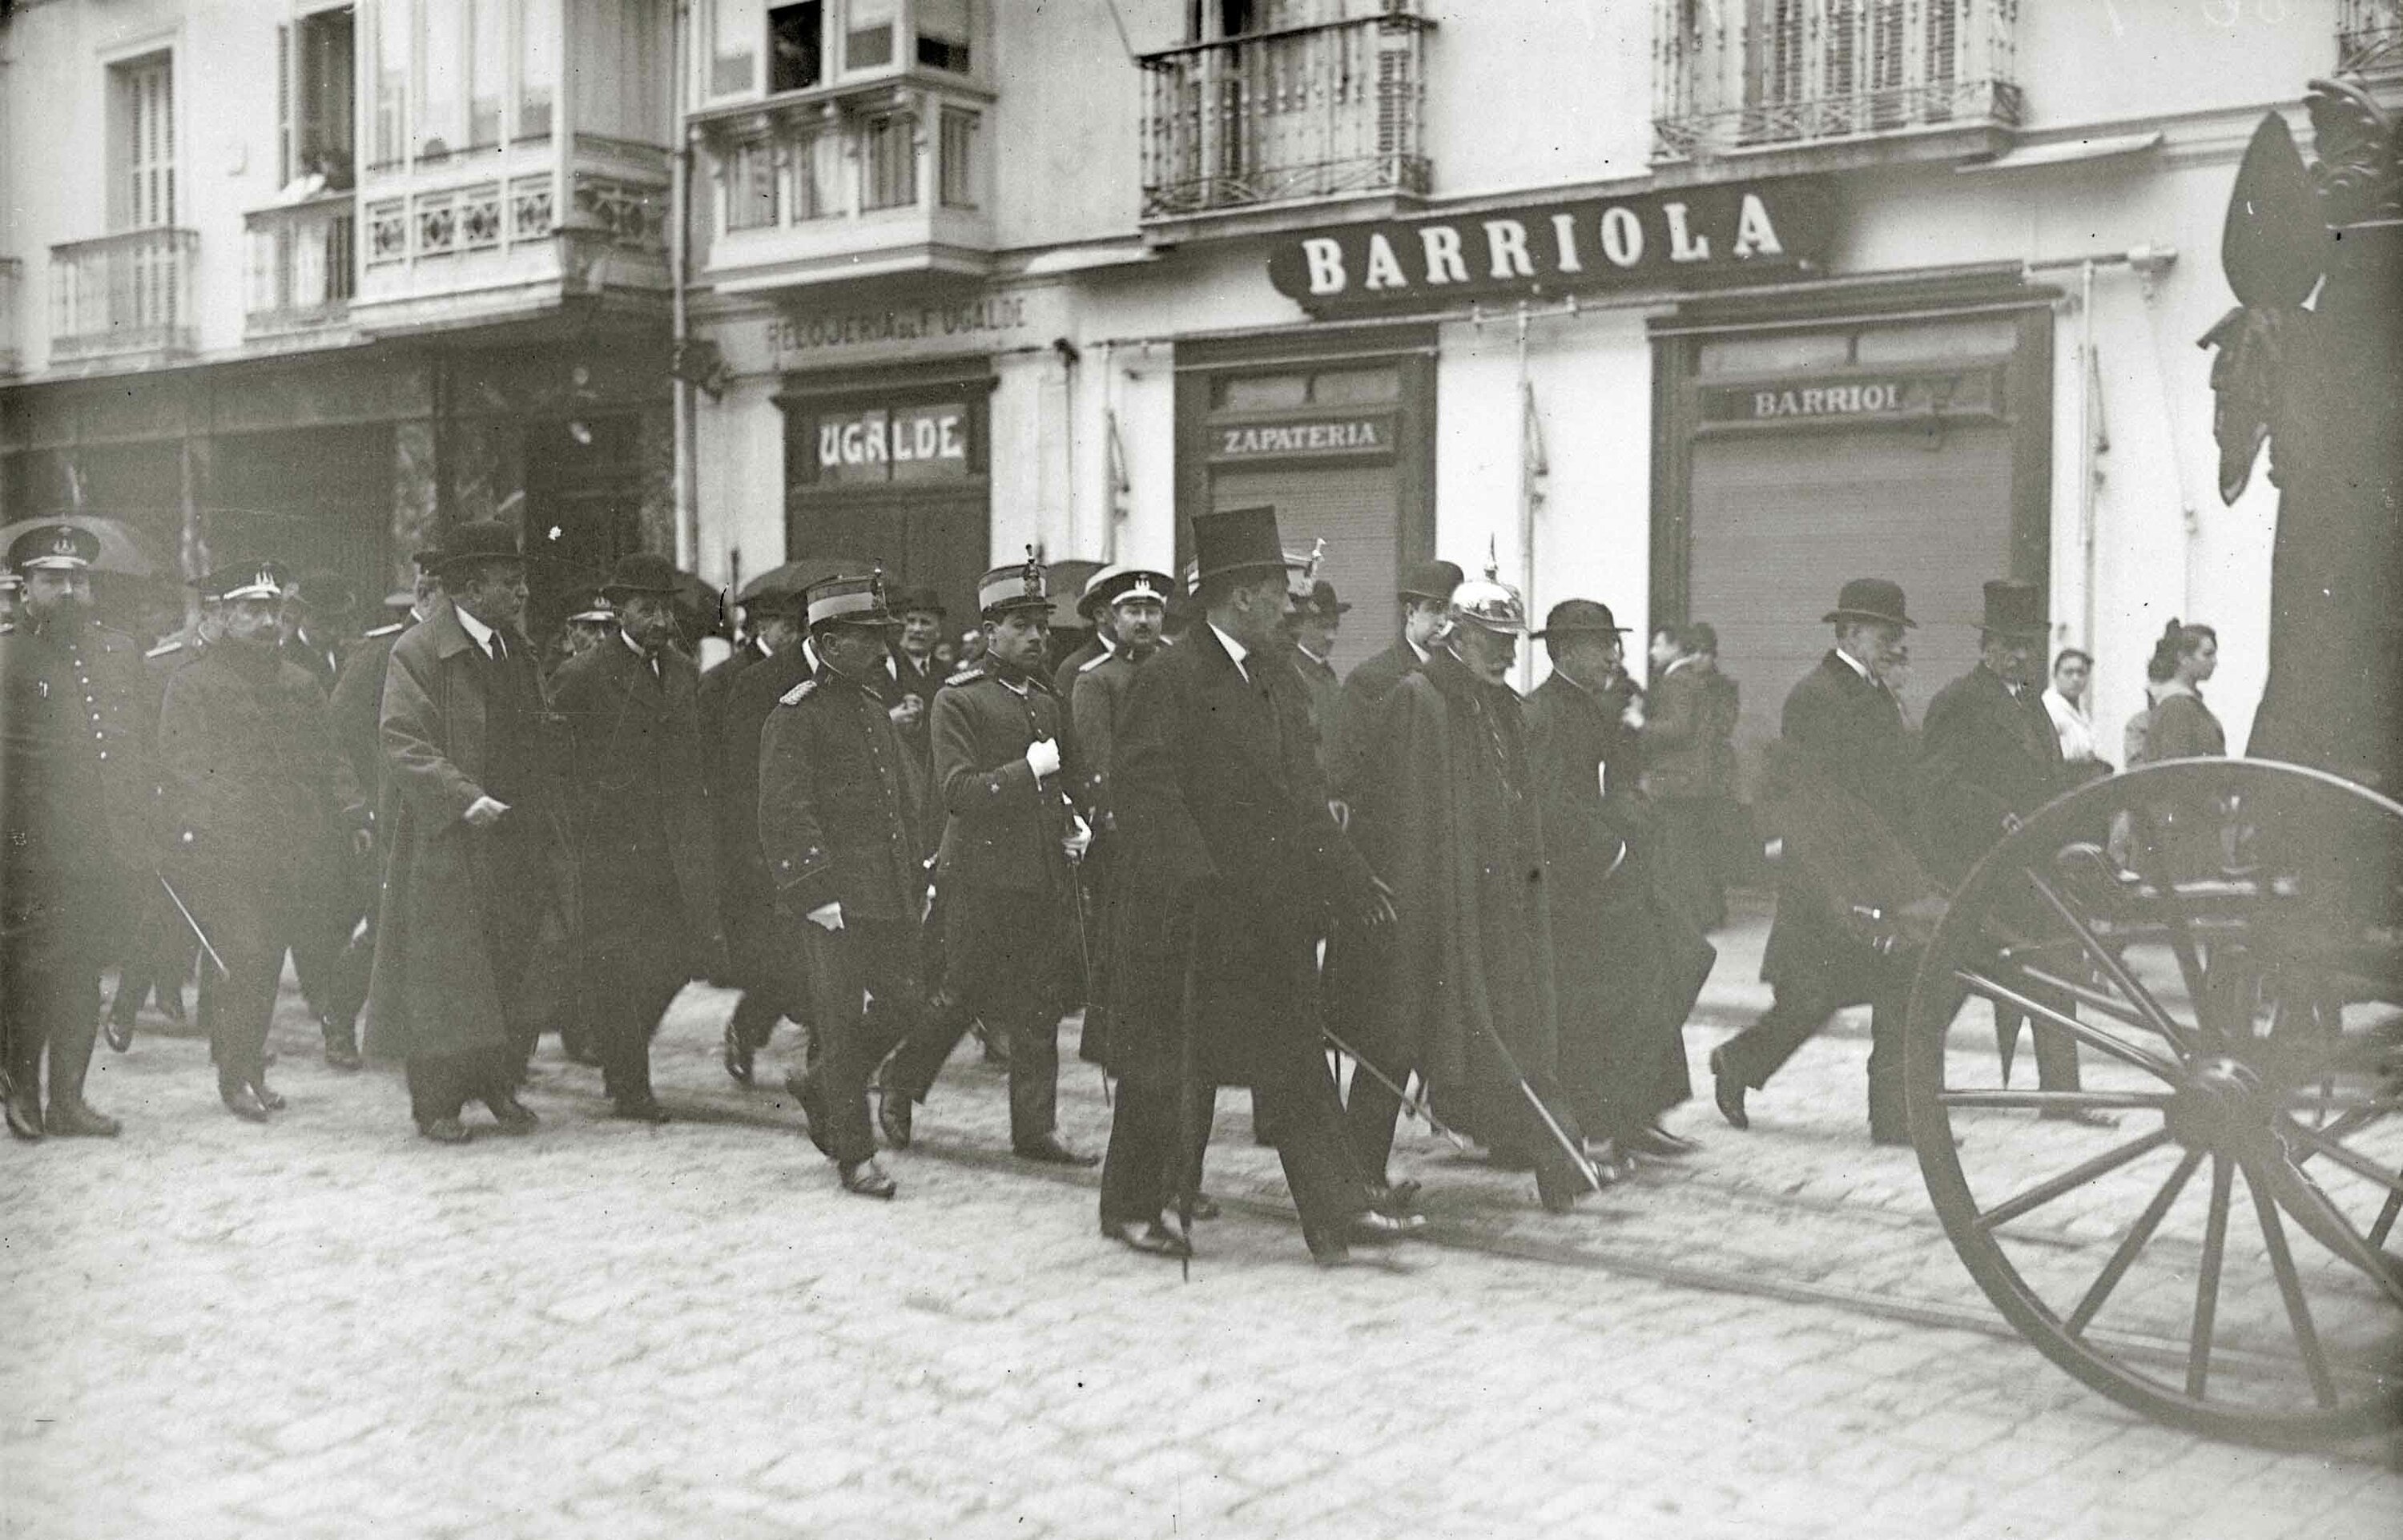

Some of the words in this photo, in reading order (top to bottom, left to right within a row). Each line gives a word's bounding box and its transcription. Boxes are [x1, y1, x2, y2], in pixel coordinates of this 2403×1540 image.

[1302, 194, 1784, 296] BARRIOLA
[819, 416, 964, 465] UGALDE
[1224, 422, 1377, 453] ZAPATERIA
